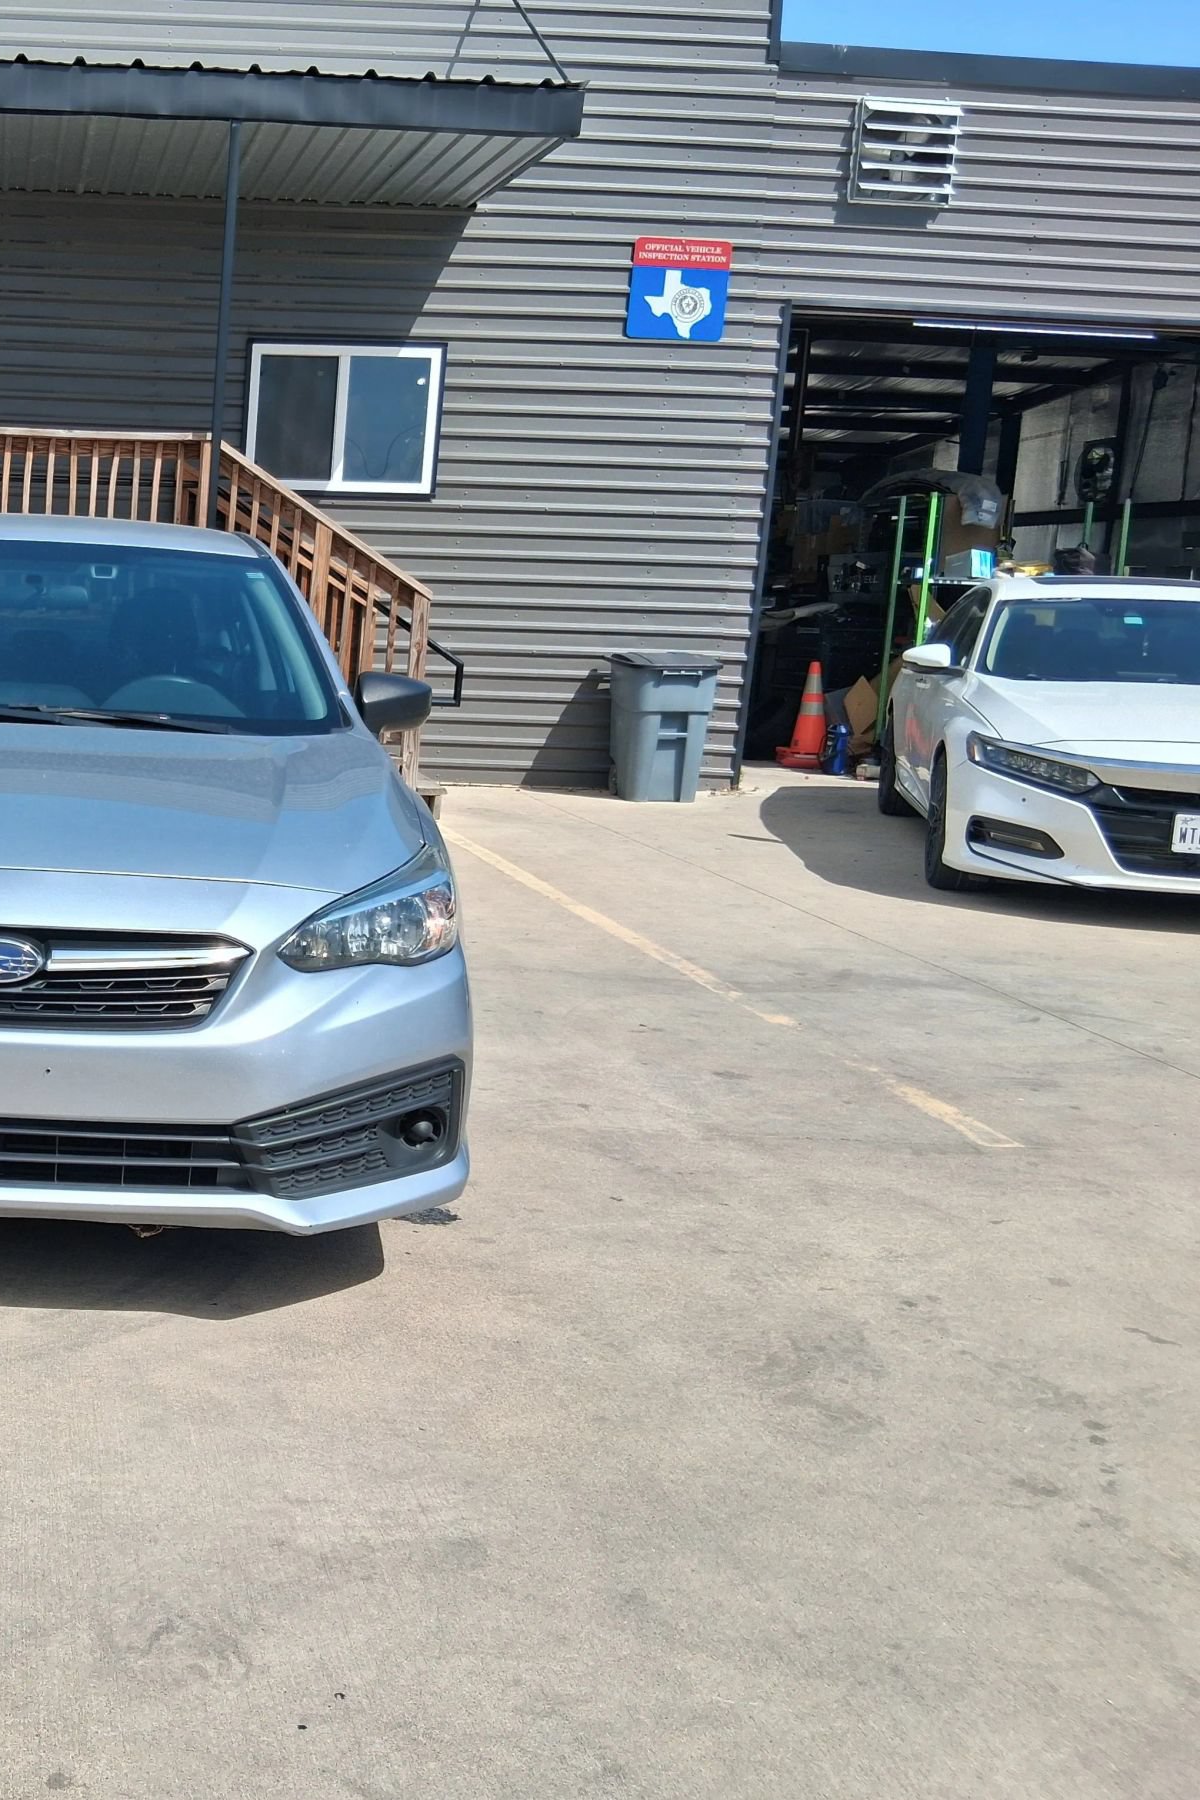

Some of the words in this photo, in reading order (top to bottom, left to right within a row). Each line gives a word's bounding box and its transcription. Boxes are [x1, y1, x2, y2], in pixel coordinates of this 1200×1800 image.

[644, 243, 685, 252] OFFICIAL
[686, 245, 722, 254] VEHICLE
[638, 252, 689, 261] INSPECTION
[690, 254, 727, 263] STATION
[1179, 826, 1200, 845] WT
